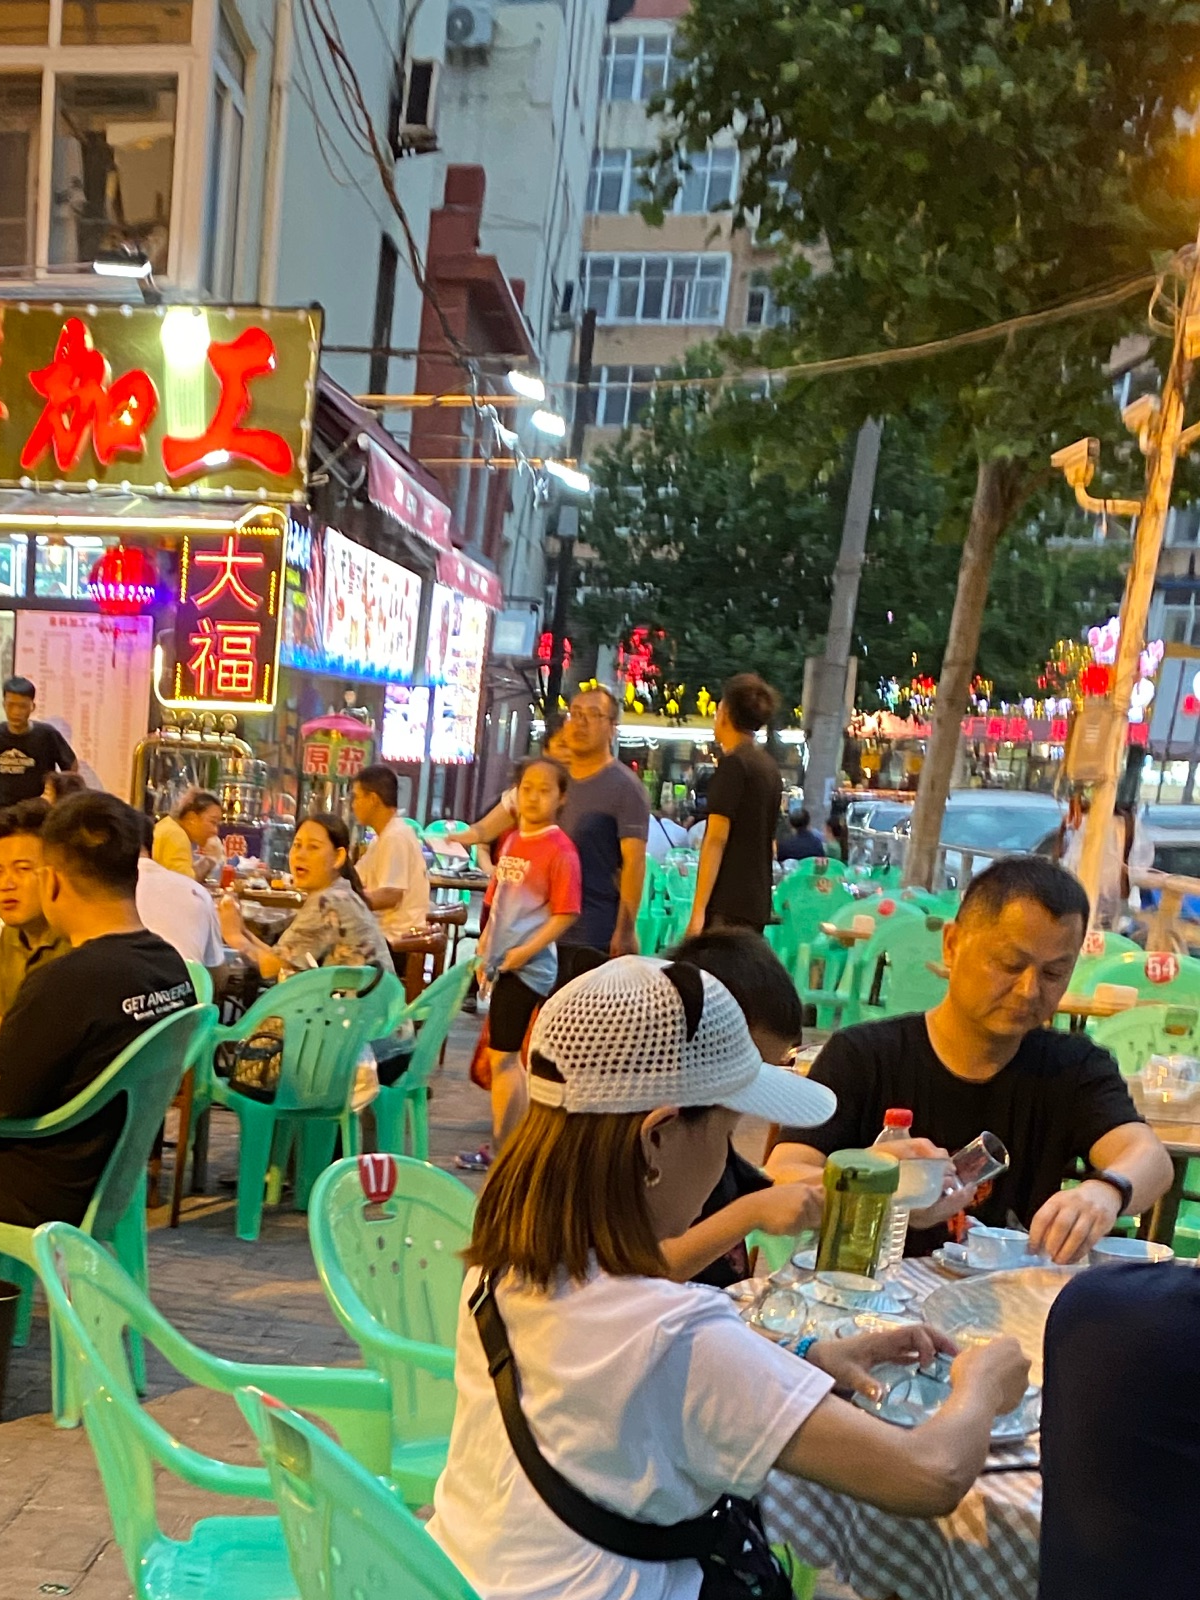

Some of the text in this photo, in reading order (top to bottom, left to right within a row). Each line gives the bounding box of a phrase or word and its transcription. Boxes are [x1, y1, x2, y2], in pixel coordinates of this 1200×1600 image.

[188, 534, 265, 697] 大福
[1147, 956, 1176, 981] 54
[122, 994, 146, 1015] GET
[362, 1153, 391, 1193] 17
